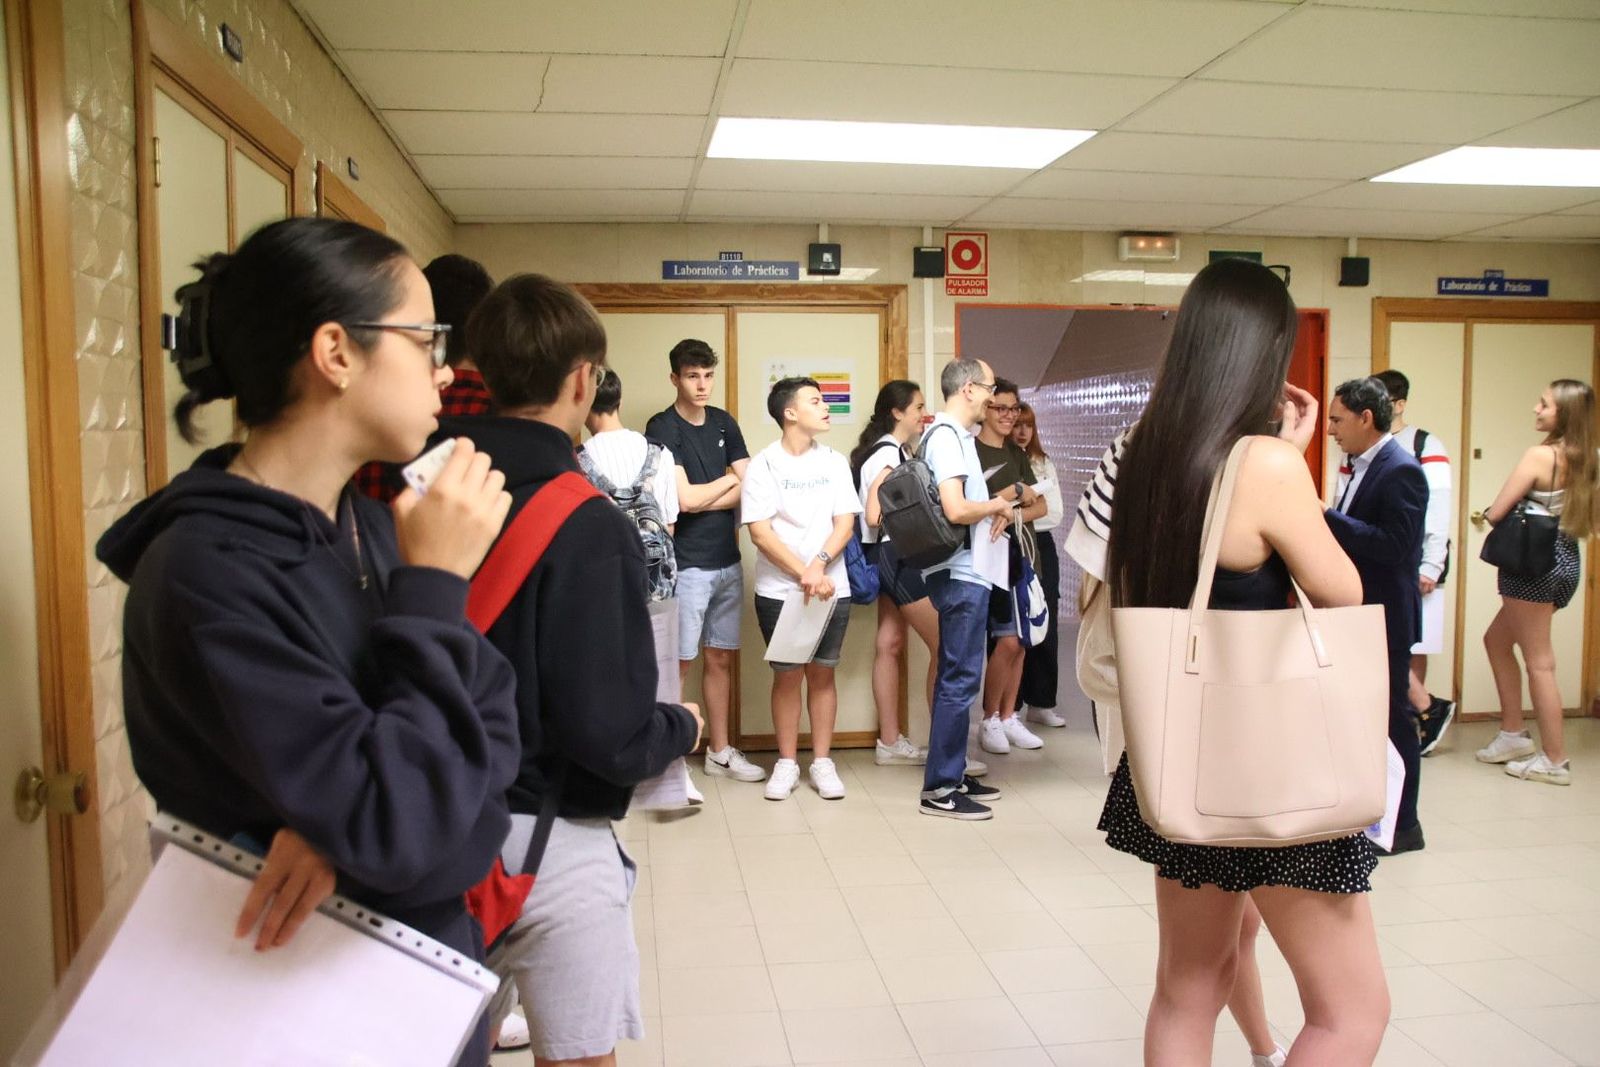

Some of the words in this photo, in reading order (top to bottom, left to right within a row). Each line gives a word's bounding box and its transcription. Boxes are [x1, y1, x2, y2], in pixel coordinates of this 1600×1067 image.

[673, 264, 728, 276] Laboratorio
[732, 265, 743, 276] de
[747, 264, 789, 276] Prácticas
[948, 279, 986, 287] PULSADOR
[1441, 280, 1486, 291] Laboratorio
[1488, 281, 1498, 291] de
